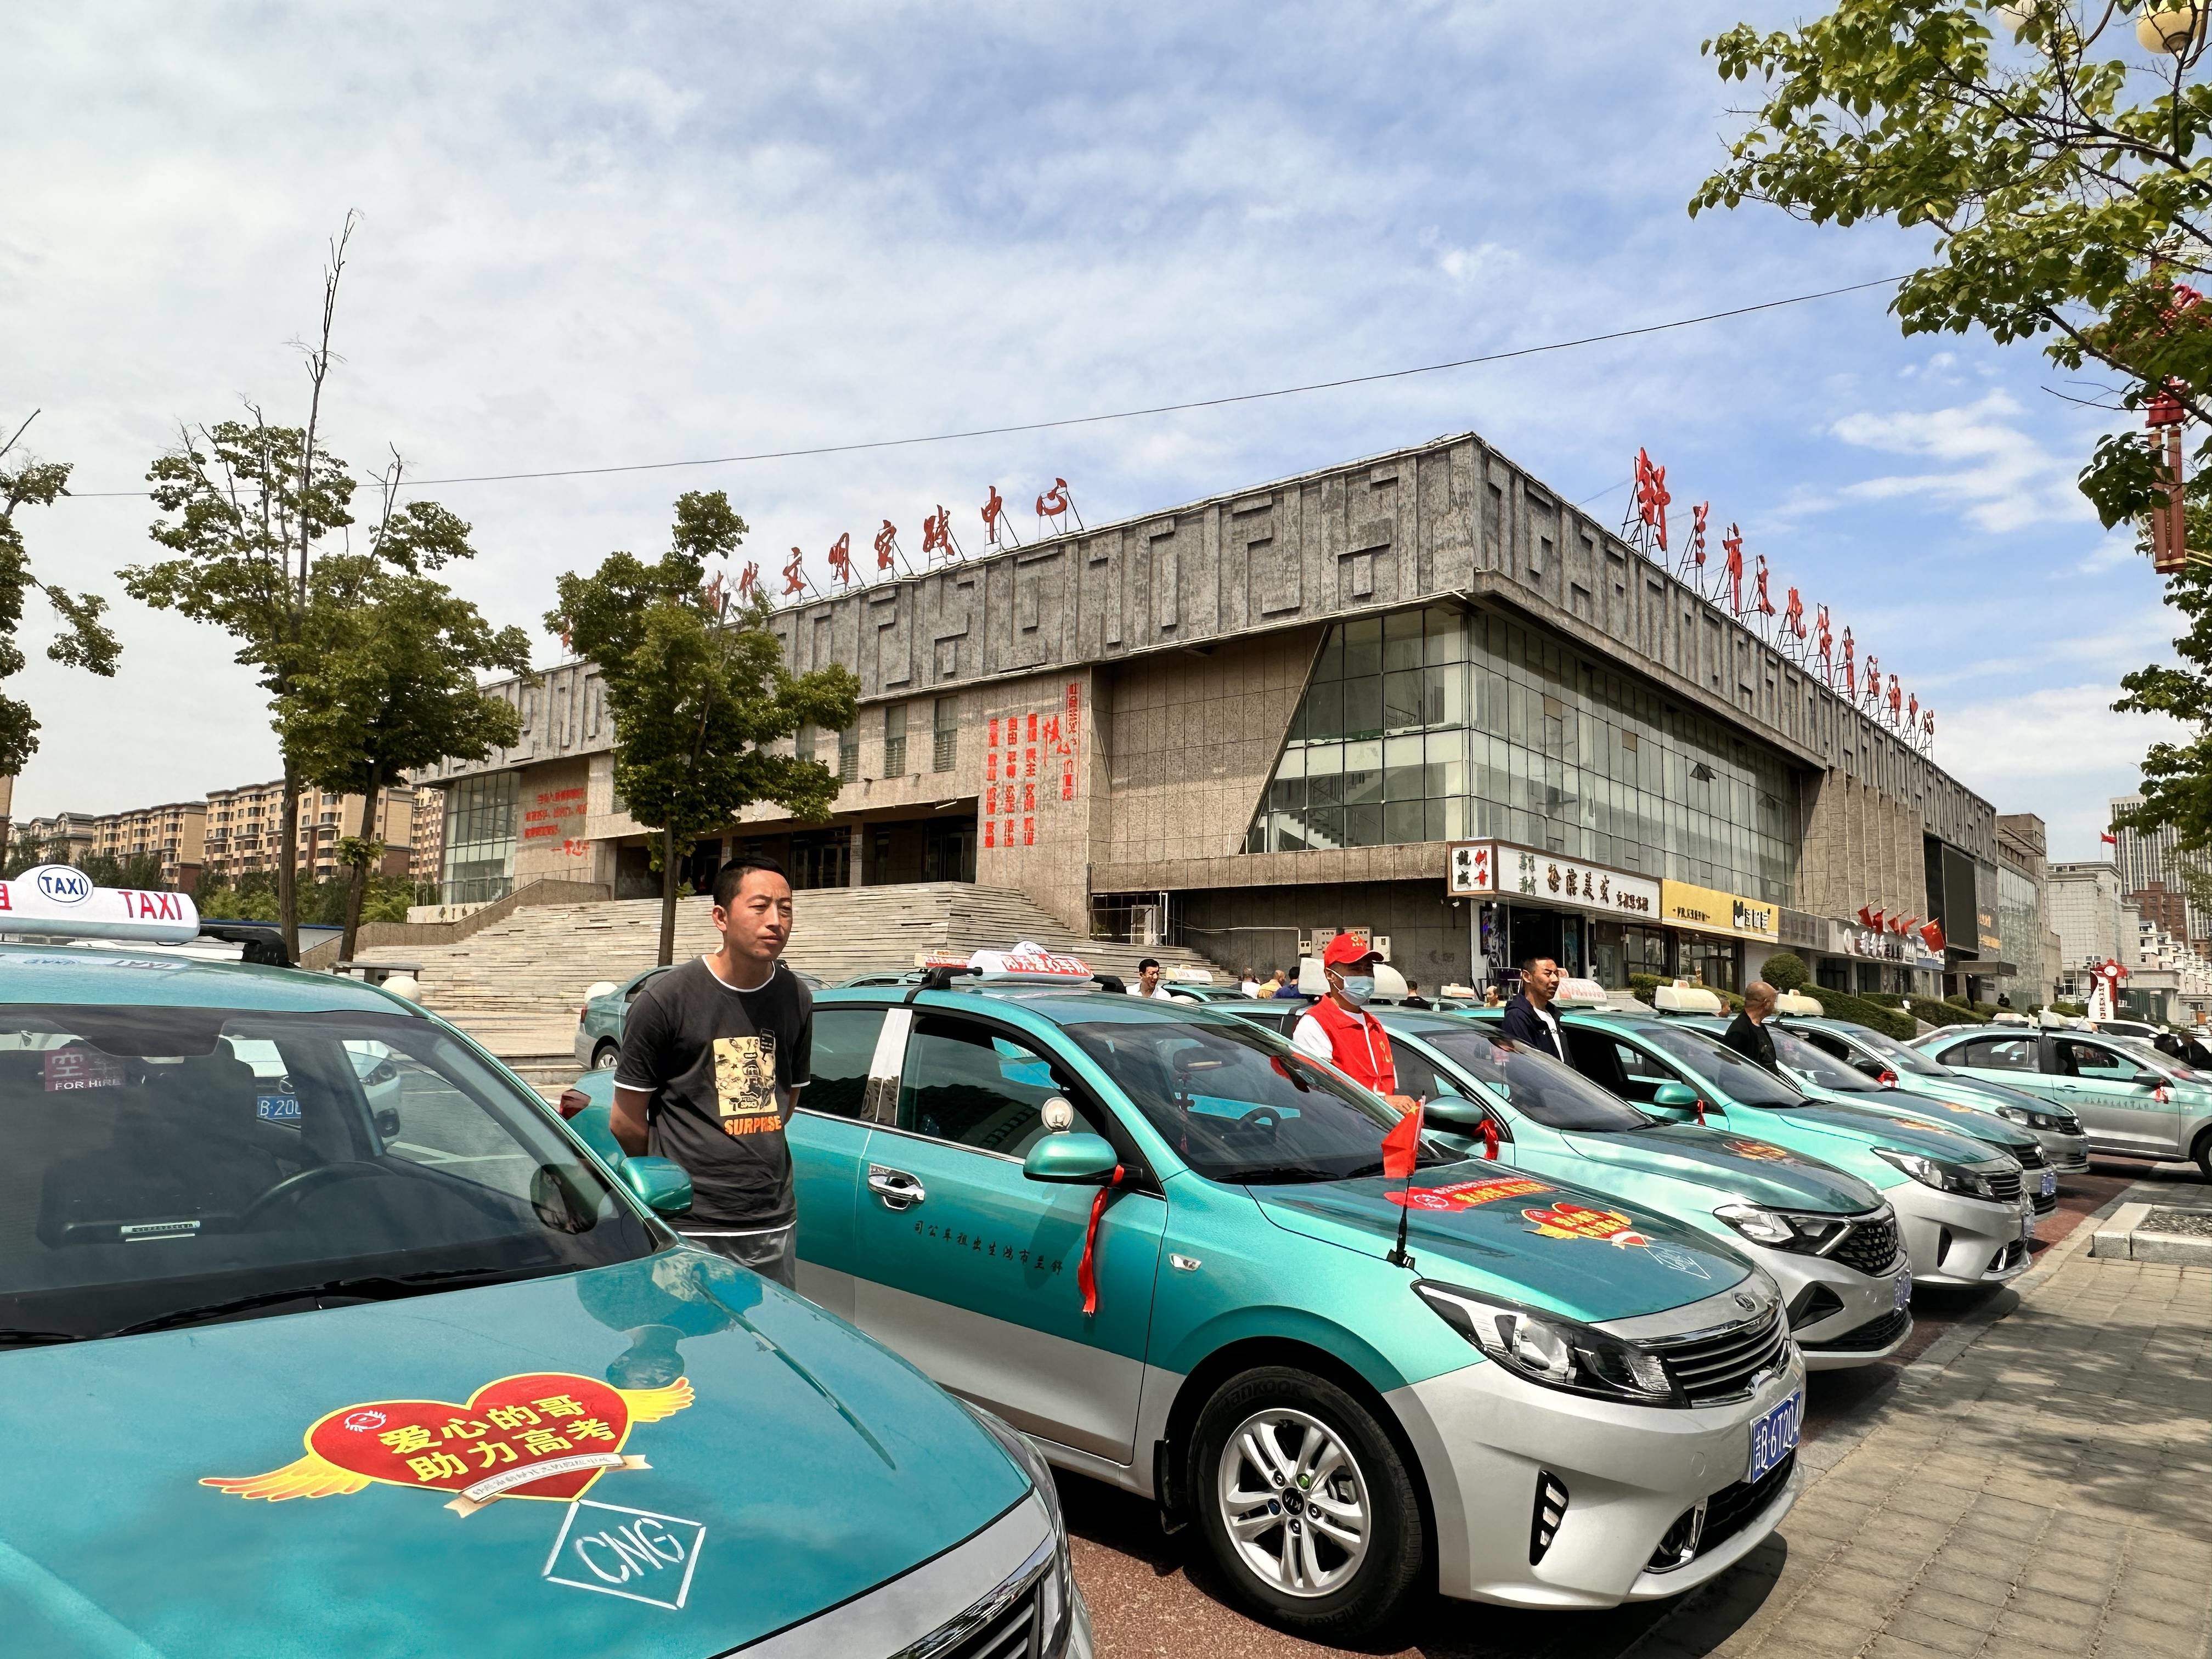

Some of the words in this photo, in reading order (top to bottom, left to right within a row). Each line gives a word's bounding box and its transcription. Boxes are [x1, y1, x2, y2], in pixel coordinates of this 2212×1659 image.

[41, 876, 84, 895] TAXI
[117, 891, 183, 921] TAXI
[55, 1081, 84, 1091] FOR
[89, 1079, 121, 1088] HIRE
[377, 1393, 586, 1457] 爱心的哥
[405, 1419, 617, 1483] 助力高考
[575, 1517, 686, 1585] CNG
